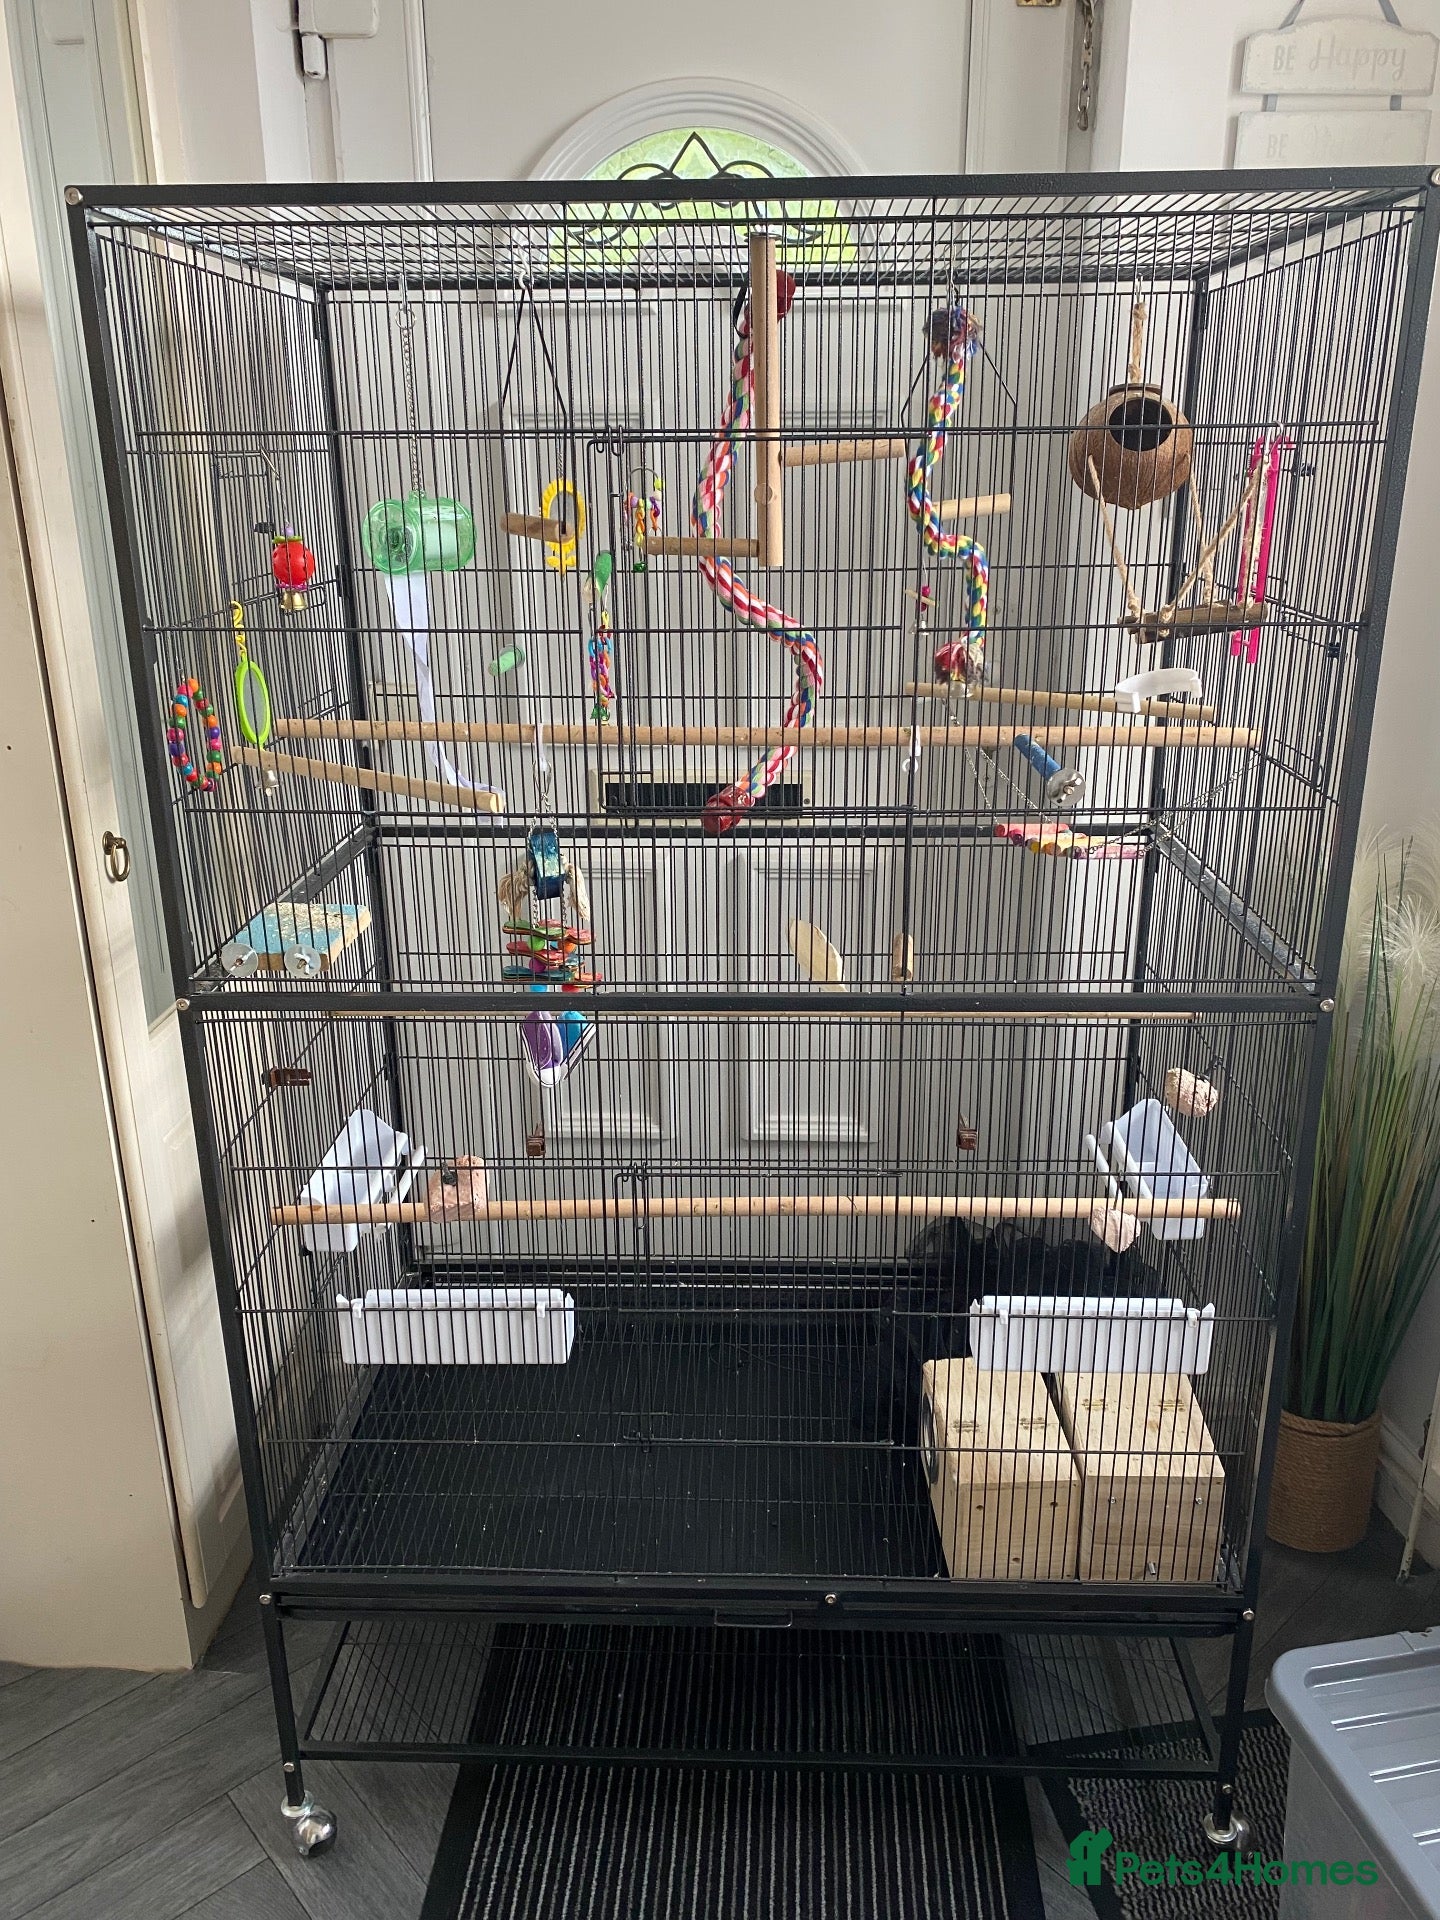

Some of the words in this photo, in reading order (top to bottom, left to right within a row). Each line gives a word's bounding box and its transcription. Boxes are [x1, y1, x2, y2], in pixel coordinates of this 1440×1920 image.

[1272, 44, 1297, 72] BE
[1308, 34, 1406, 81] Happy
[1266, 133, 1289, 158] BE
